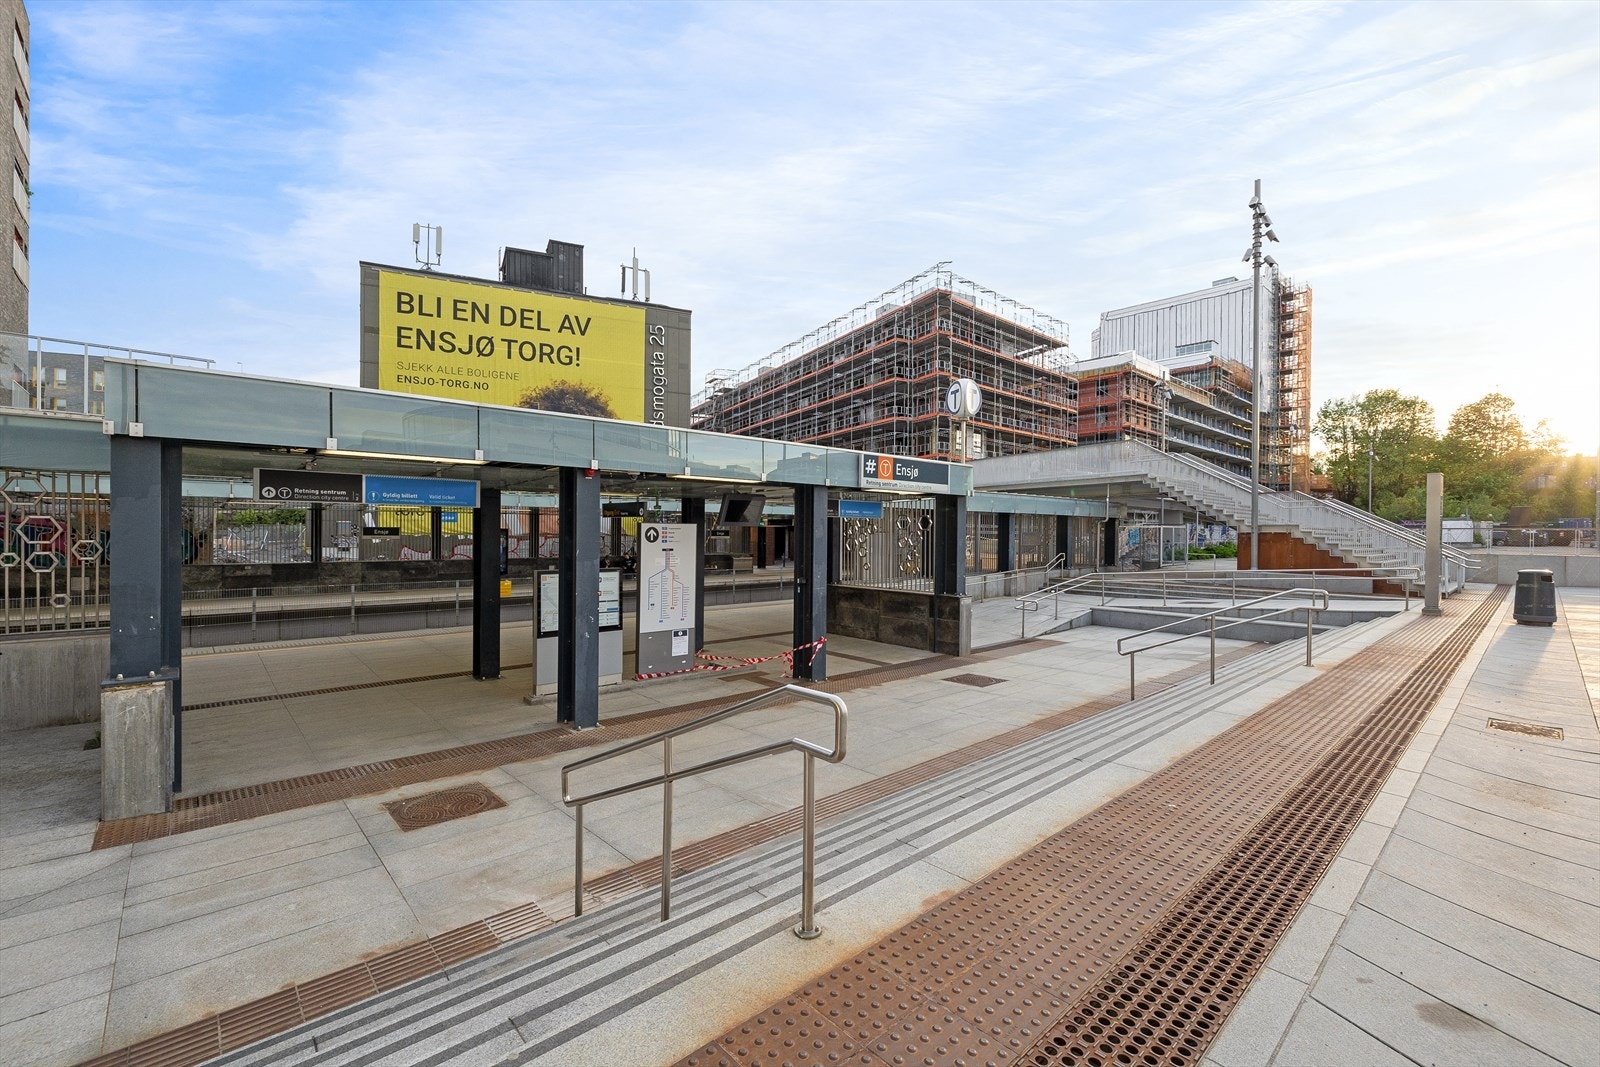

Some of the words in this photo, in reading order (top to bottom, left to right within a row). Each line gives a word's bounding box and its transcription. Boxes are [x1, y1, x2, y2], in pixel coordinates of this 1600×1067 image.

[396, 291, 442, 318] BLI
[453, 299, 490, 325] EN
[500, 305, 550, 332] DEL
[557, 314, 592, 337] AV
[649, 324, 665, 347] 25
[396, 326, 495, 358] ENSJØ
[500, 338, 581, 367] TORG!
[396, 361, 434, 374] SJEKK
[437, 365, 465, 377] ALLE
[467, 367, 520, 382] BOLIGENE
[396, 374, 490, 391] ENSJO-TORG.NO
[896, 463, 919, 480] Ensjø
[294, 487, 319, 496] Retning
[320, 488, 347, 496] sentrum
[294, 493, 321, 501] Direction
[382, 492, 401, 500] Gyldig
